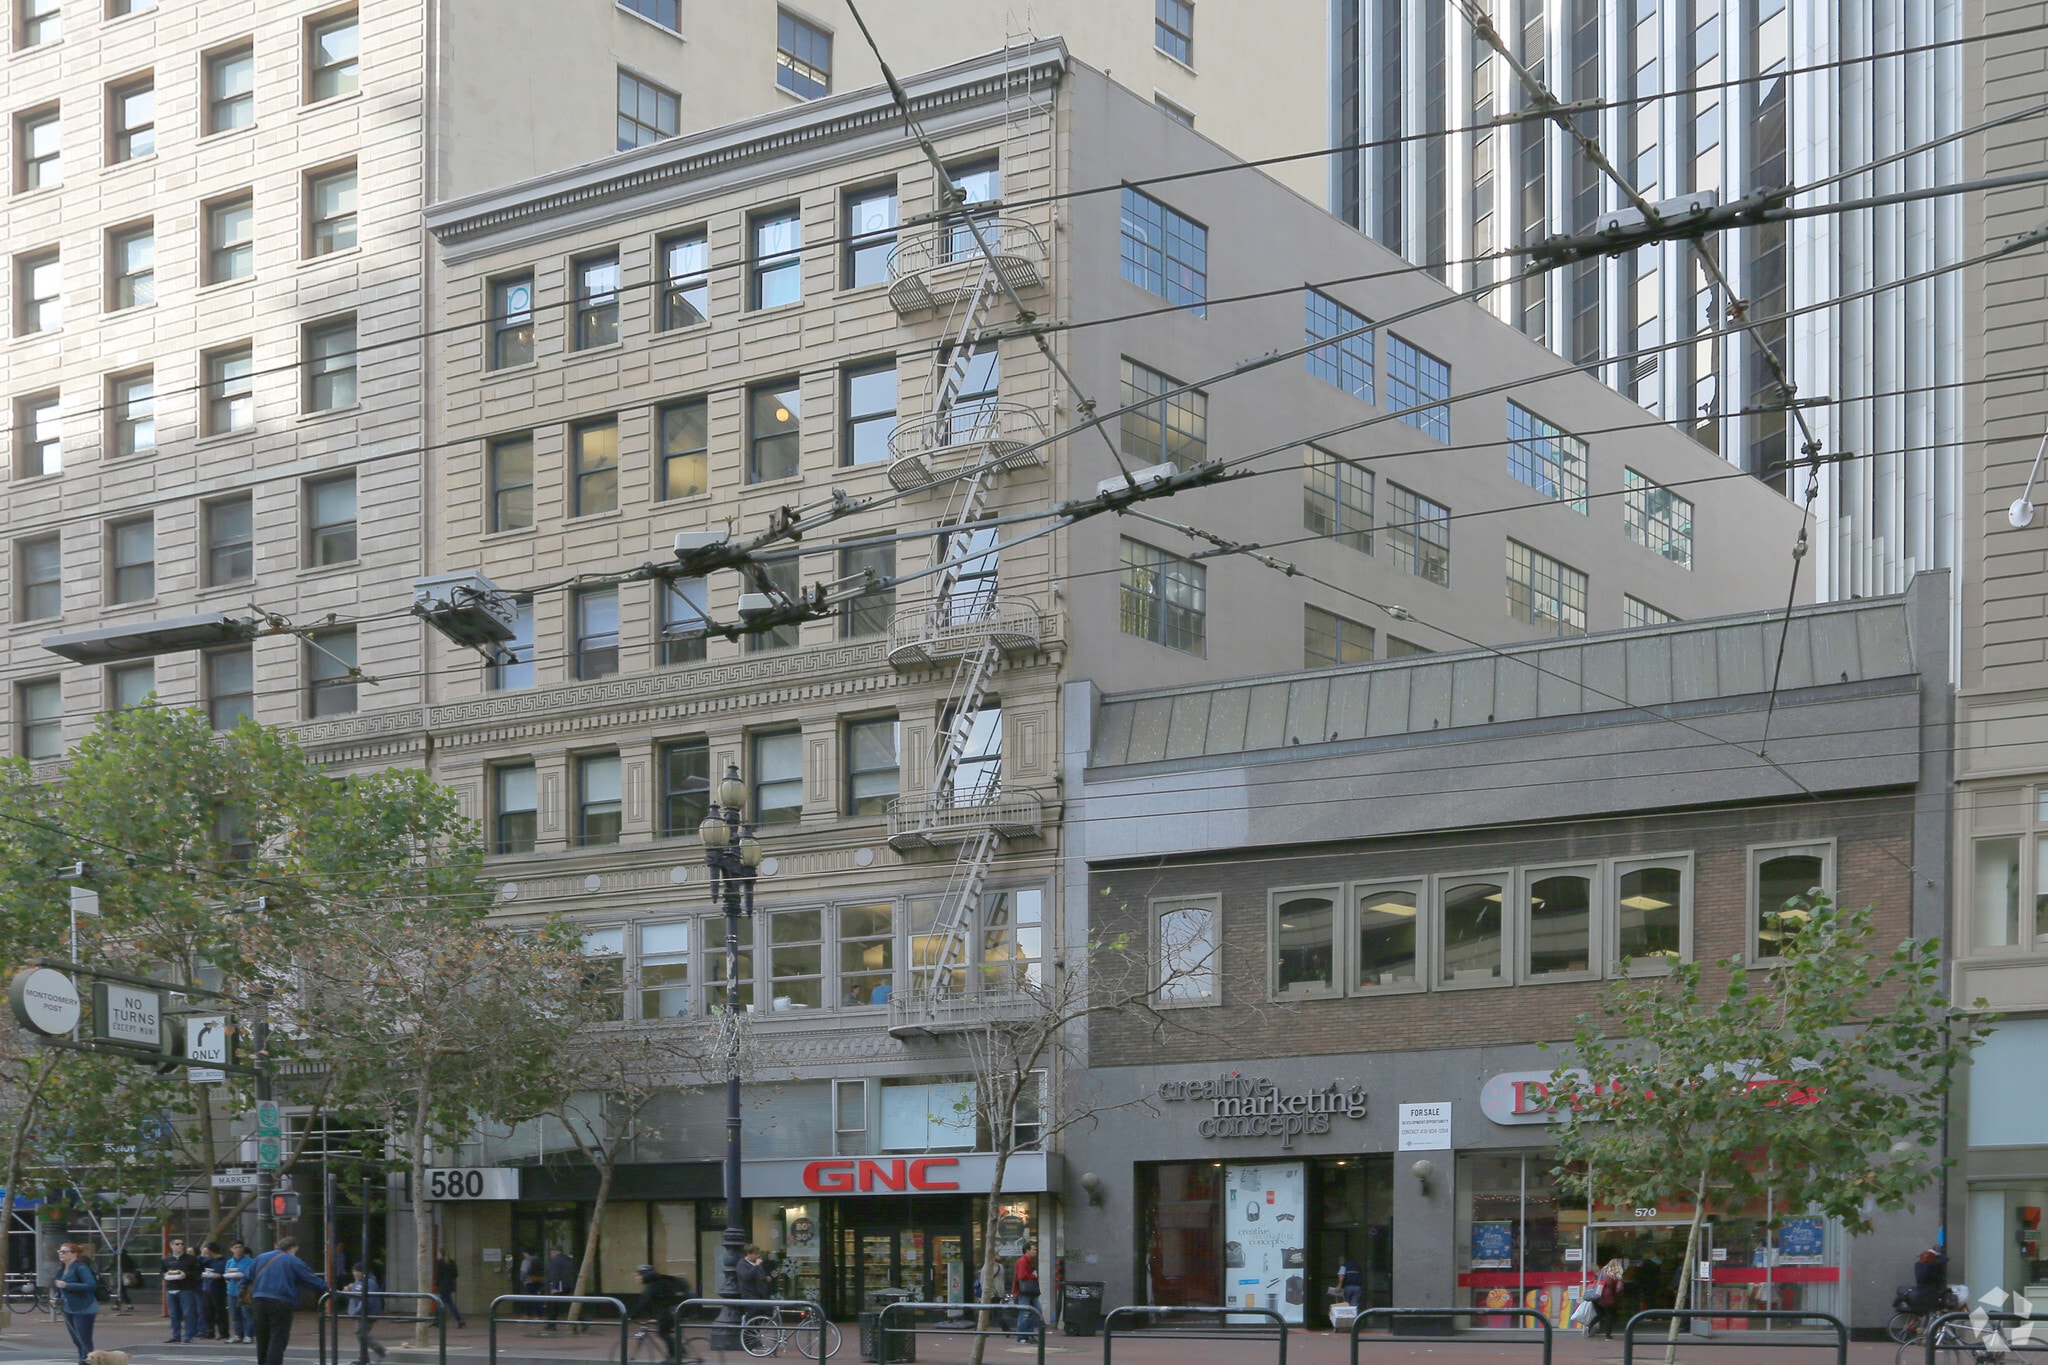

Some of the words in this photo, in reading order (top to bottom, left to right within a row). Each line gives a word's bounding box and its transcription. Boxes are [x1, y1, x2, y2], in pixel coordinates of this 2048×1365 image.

[26, 988, 78, 1007] MONTGOMERY
[125, 997, 142, 1009] NO
[43, 1002, 63, 1013] POST
[113, 1008, 155, 1026] TURNS
[112, 1022, 136, 1033] EXCEPT
[192, 1049, 220, 1060] ONLY
[1158, 1071, 1273, 1100] creative
[1211, 1087, 1368, 1119] marketing
[1410, 1109, 1424, 1117] FOR
[1424, 1108, 1440, 1116] SALE
[1198, 1107, 1330, 1149] concepts
[218, 1176, 251, 1184] MARKET
[803, 1158, 959, 1192] GNC
[431, 1170, 483, 1197] 580
[1635, 1208, 1657, 1217] 570
[1238, 1228, 1270, 1236] creative
